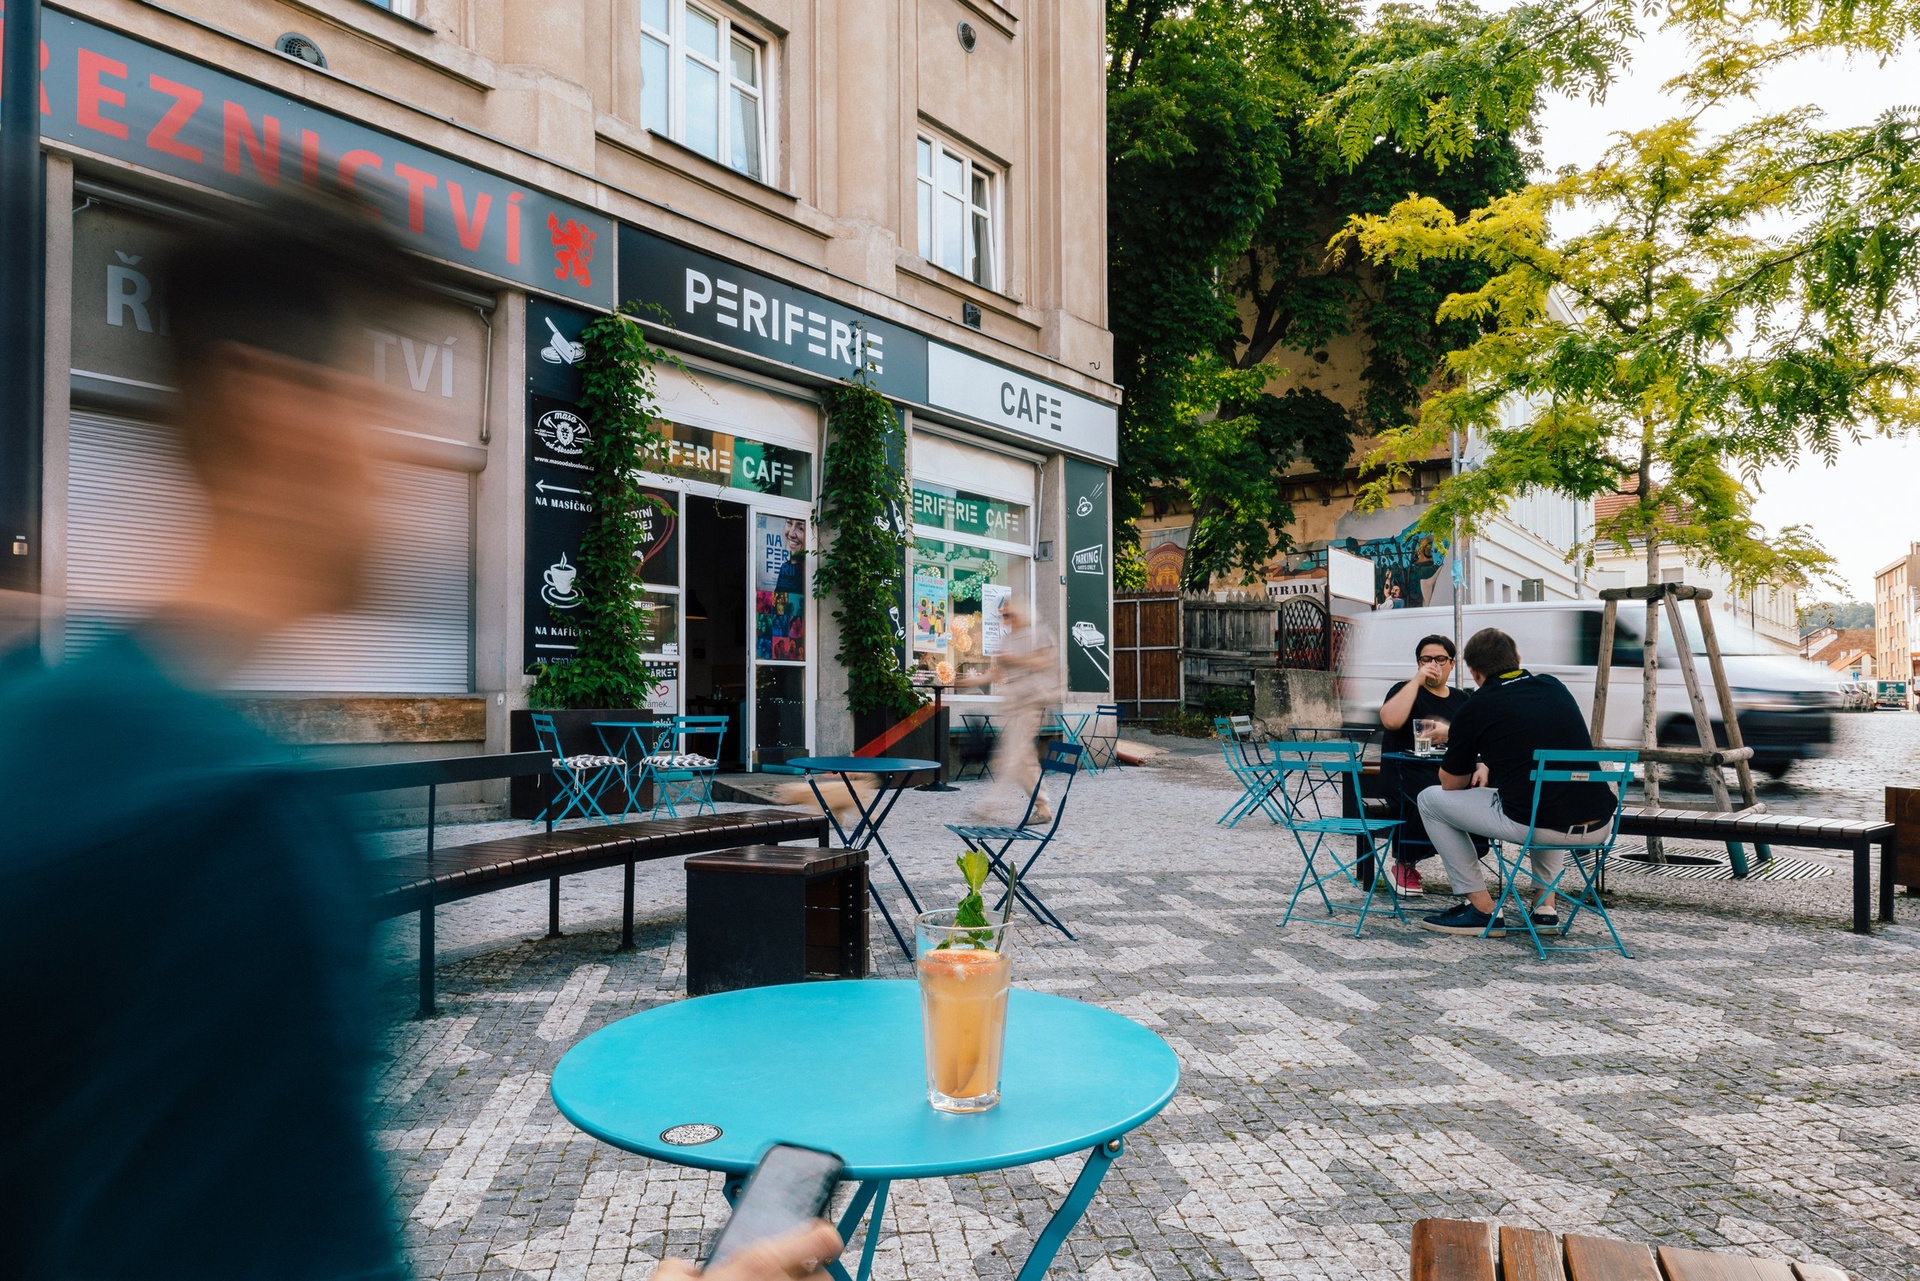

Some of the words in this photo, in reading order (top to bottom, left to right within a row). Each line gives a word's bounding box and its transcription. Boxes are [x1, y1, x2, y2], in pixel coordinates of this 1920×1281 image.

[0, 0, 525, 266] EZNICTVÍ
[685, 267, 884, 375] PERIFERIE
[1000, 381, 1062, 432] CAFE
[554, 412, 578, 424] maso
[630, 431, 731, 474] RFERIE
[742, 456, 794, 487] CAFE
[535, 496, 548, 507] NA
[551, 498, 593, 513] MASÍČKO
[621, 505, 654, 520] OTNÍ
[914, 492, 978, 524] ERIFERIE
[985, 508, 1019, 532] CAFE
[766, 533, 783, 548] NA
[1075, 549, 1099, 565] PARKING
[534, 625, 548, 636] NA
[646, 668, 678, 678] ARKET
